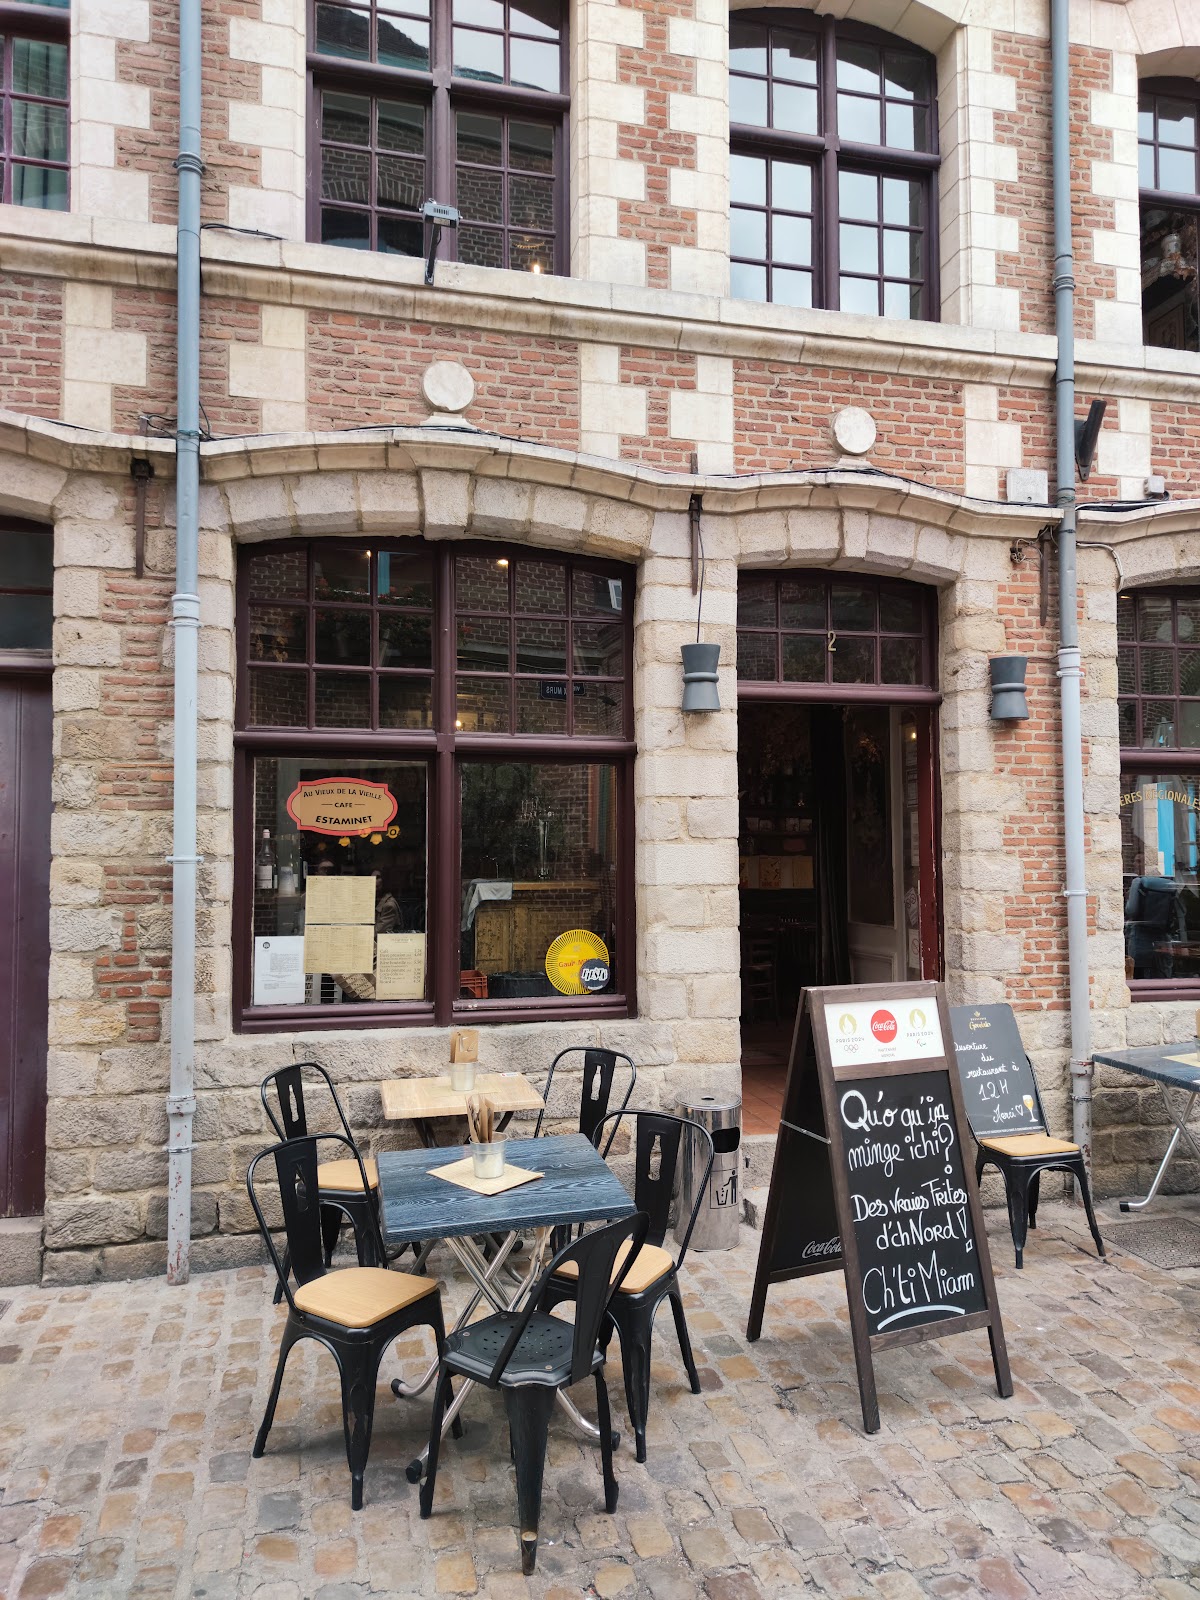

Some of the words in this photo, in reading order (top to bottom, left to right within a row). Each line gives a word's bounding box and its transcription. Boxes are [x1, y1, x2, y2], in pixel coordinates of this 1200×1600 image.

[827, 630, 837, 652] 2
[315, 788, 335, 797] VIEUX
[348, 788, 357, 796] LA
[358, 789, 382, 801] VIEILLE
[315, 815, 373, 825] ESTAMINET
[872, 1019, 896, 1032] Coca-Cola
[980, 1053, 995, 1062] du
[965, 1063, 1009, 1079] restaurant
[1011, 1061, 1020, 1072] à
[848, 1137, 905, 1178] minge
[850, 1194, 889, 1223] Des
[917, 1249, 975, 1303] Miam
